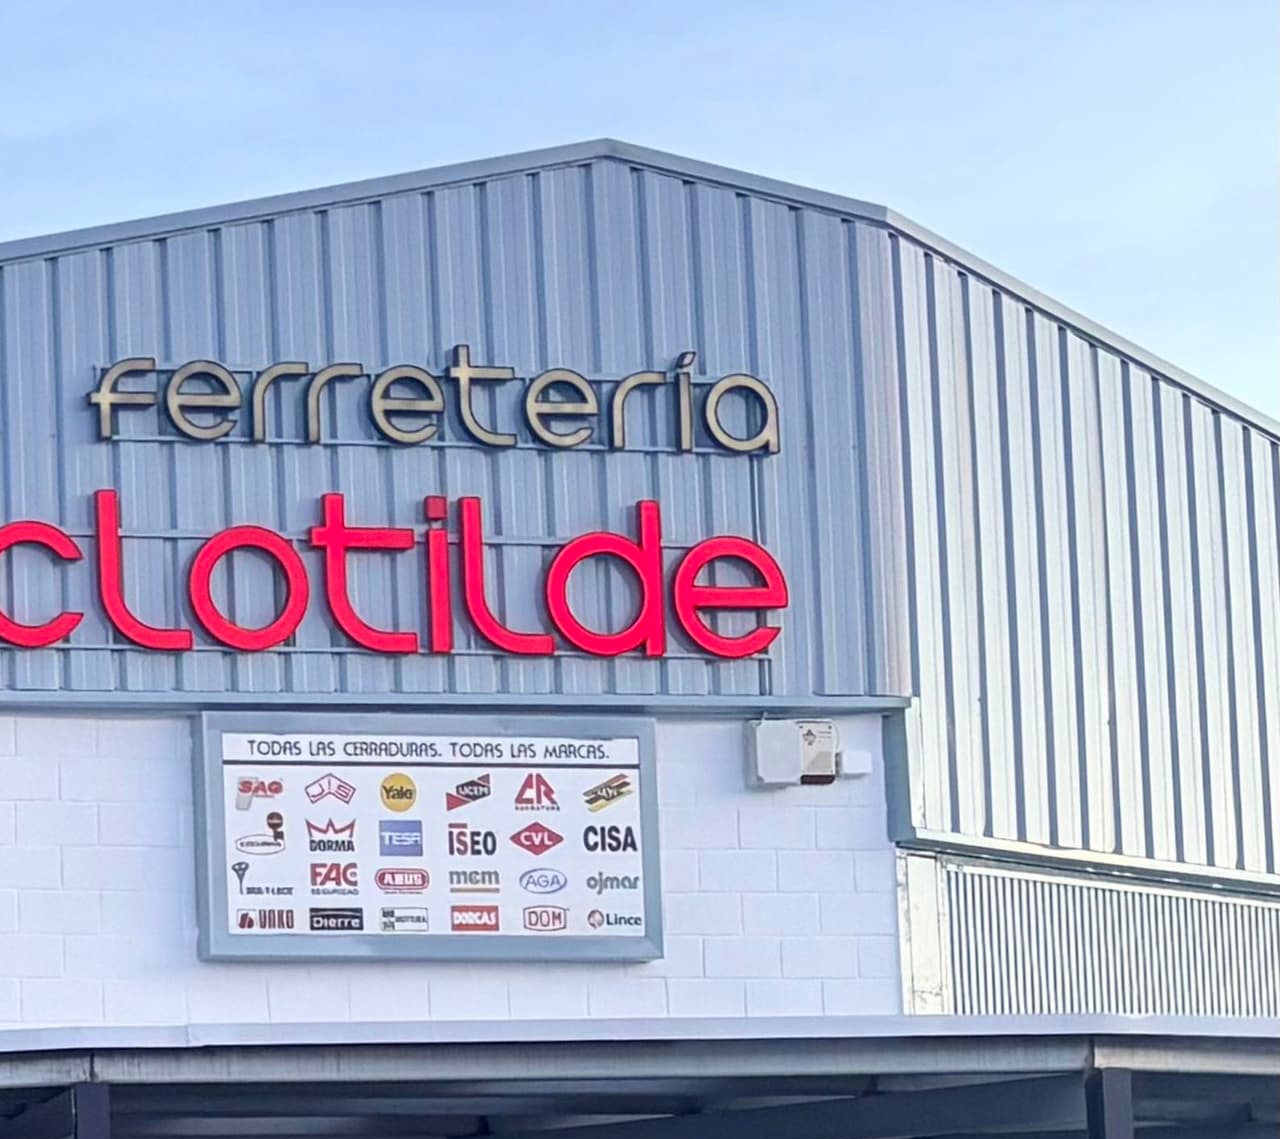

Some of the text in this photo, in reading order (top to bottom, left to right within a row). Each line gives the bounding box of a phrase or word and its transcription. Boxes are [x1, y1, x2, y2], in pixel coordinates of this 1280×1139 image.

[91, 344, 780, 454] ferretería
[248, 740, 610, 760] TODAS LAS CERRADURAS. TODAS LAS MARCAS.
[382, 785, 414, 800] Yale
[309, 839, 355, 852] DORMA
[382, 831, 421, 845] TESA
[448, 830, 497, 856] ISEO
[520, 833, 553, 846] CVL
[583, 826, 638, 852] CISA
[311, 863, 358, 887] FAC
[449, 870, 500, 885] mcm
[525, 875, 561, 889] AGA
[586, 872, 640, 895] ojmar
[313, 917, 360, 928] Dierre
[453, 911, 497, 926] DORCAS
[528, 910, 561, 927] DOM
[606, 914, 642, 926] Lince
